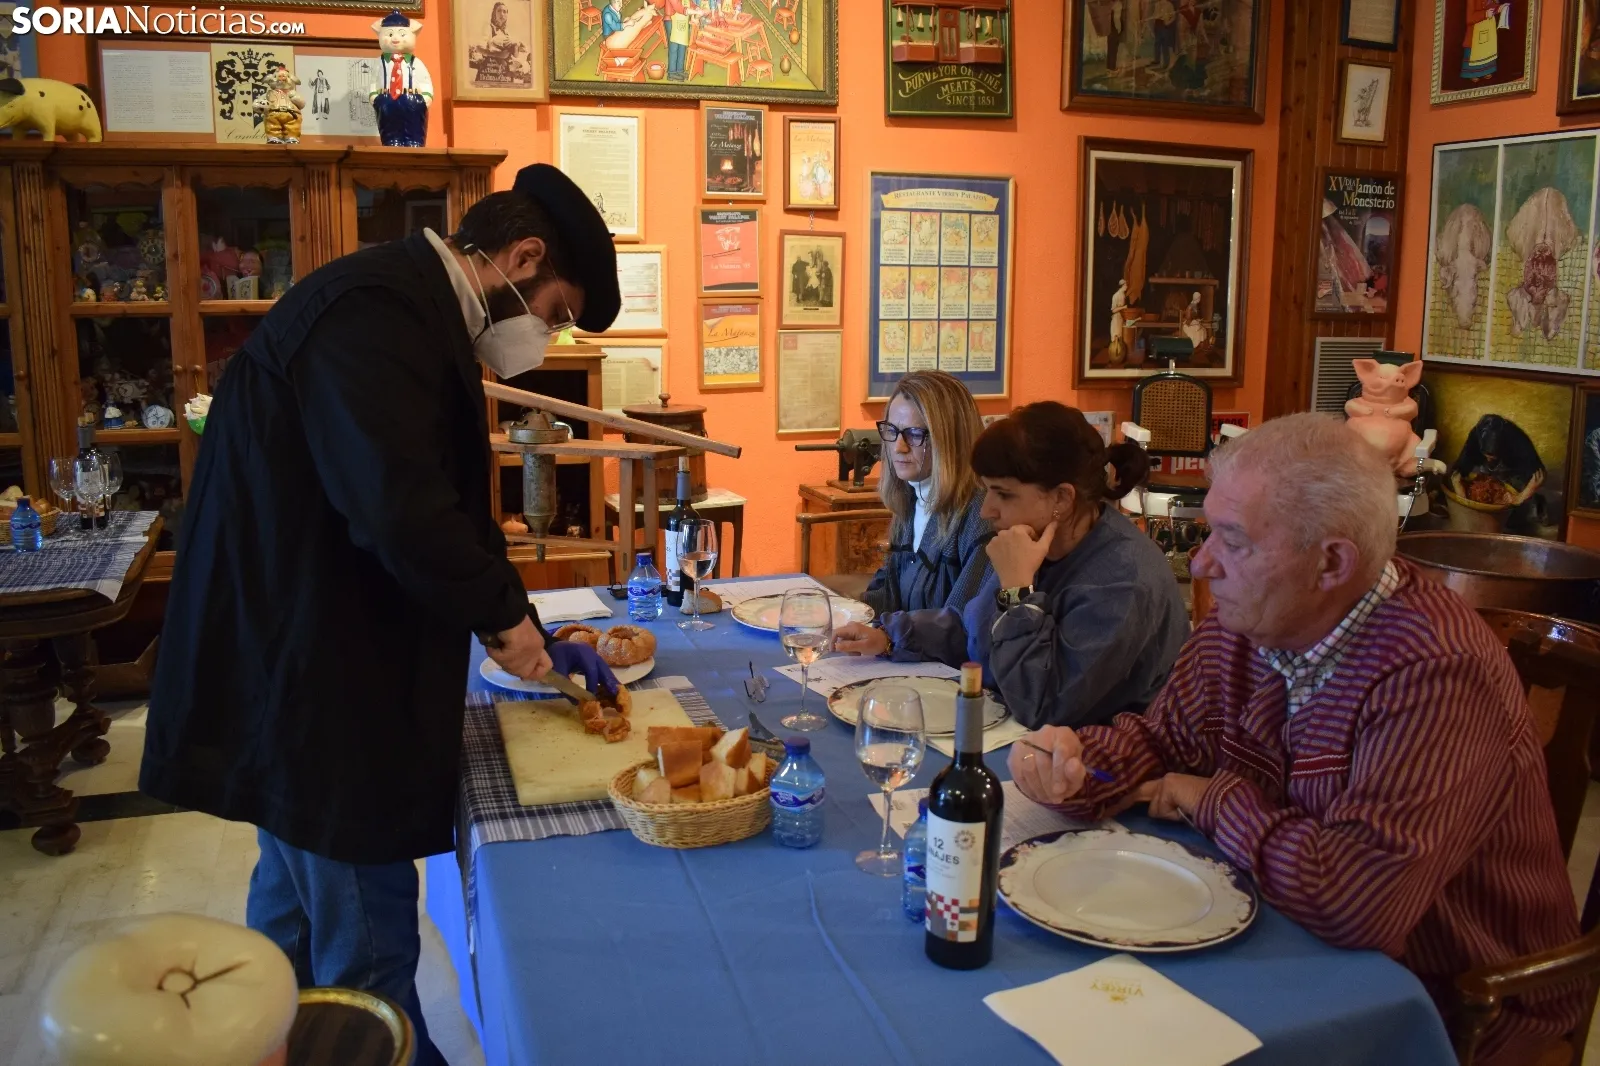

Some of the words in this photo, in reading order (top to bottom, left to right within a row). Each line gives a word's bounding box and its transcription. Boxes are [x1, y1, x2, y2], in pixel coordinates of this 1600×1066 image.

[905, 65, 957, 92] PURVEYOR
[940, 80, 977, 96] MEATS
[946, 95, 974, 105] SINCE
[978, 96, 995, 106] 1851
[1355, 177, 1383, 197] Jamón
[1384, 181, 1395, 195] de
[1342, 191, 1395, 209] Monesterio
[933, 836, 945, 850] 12
